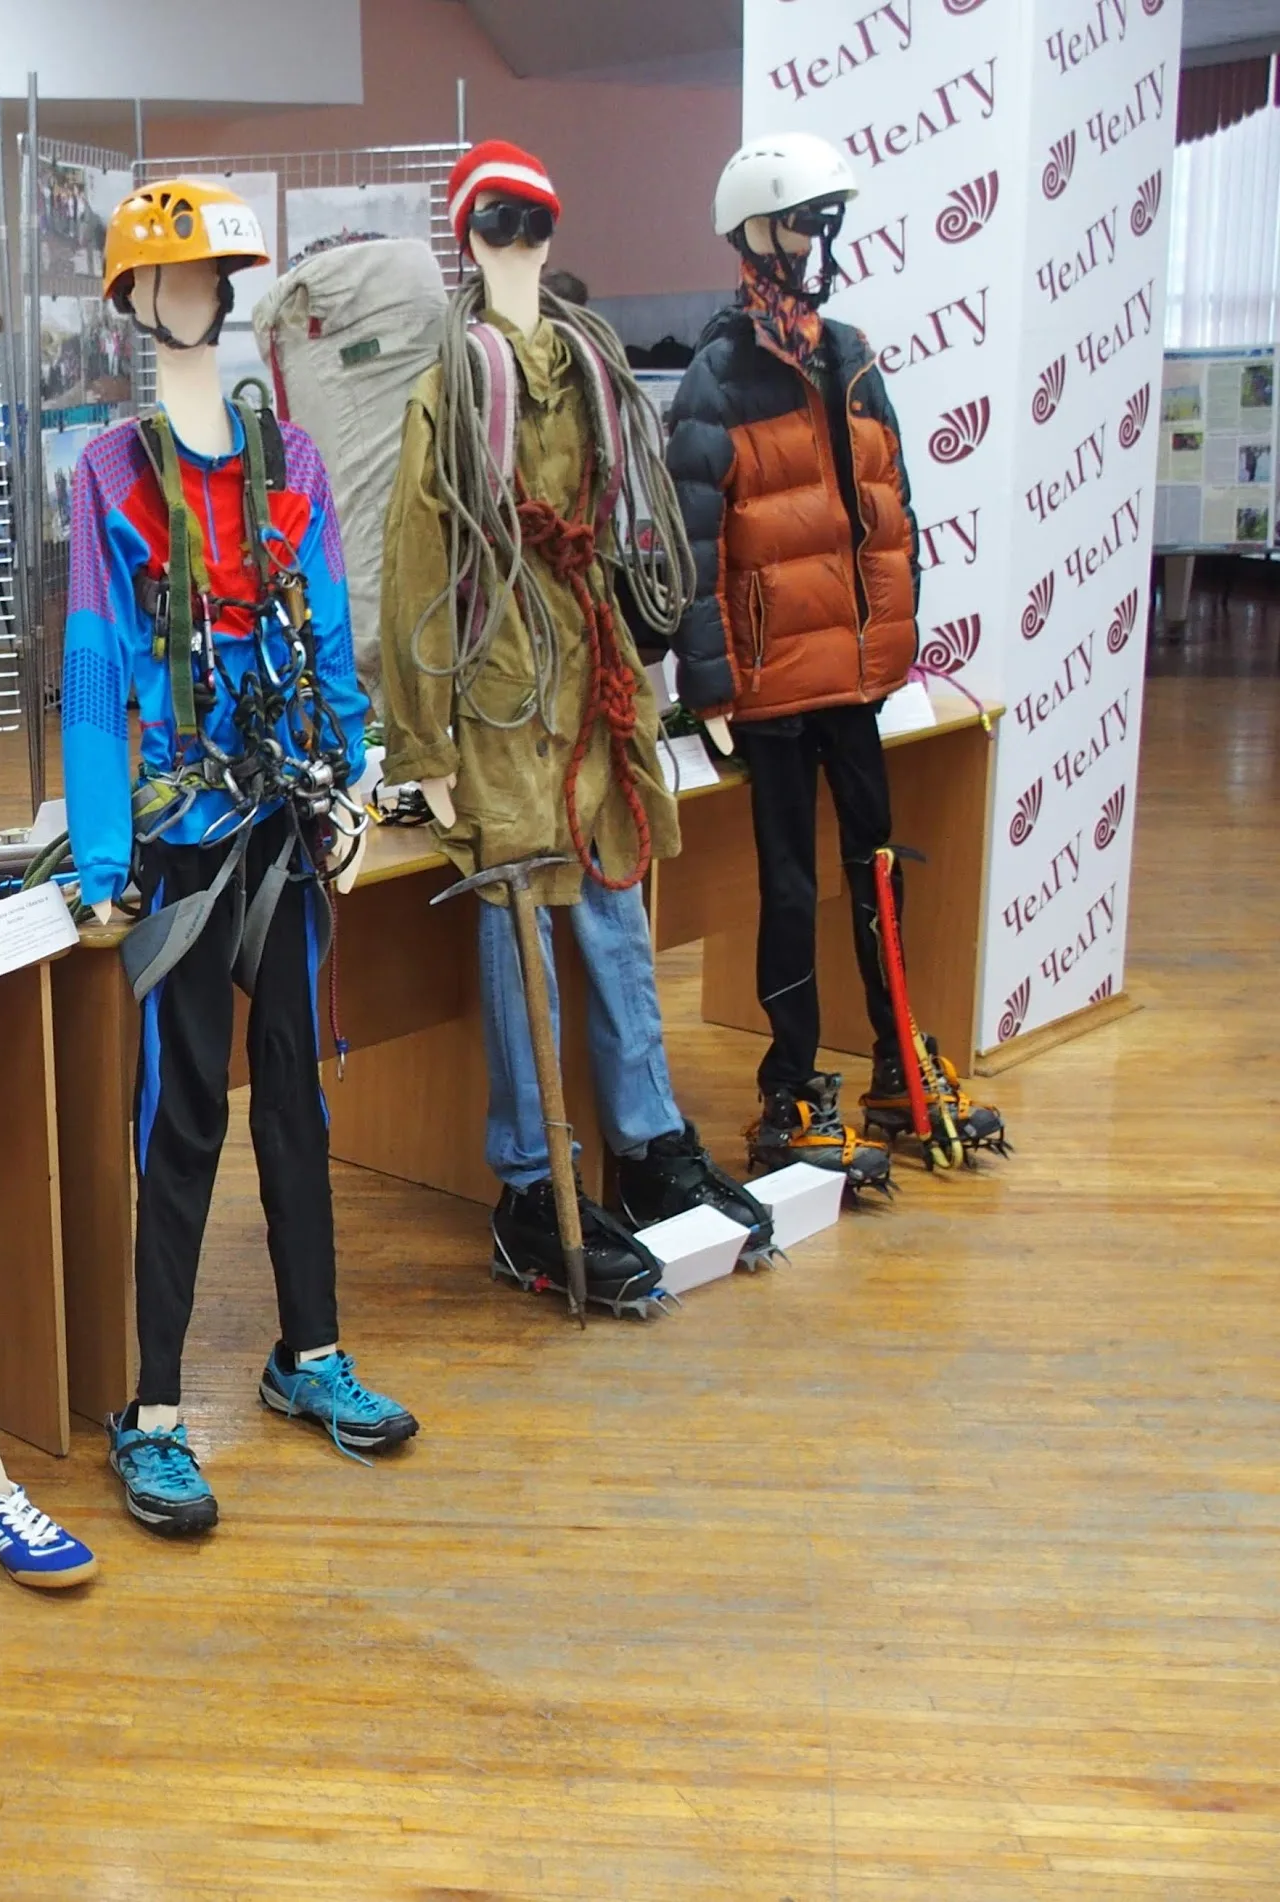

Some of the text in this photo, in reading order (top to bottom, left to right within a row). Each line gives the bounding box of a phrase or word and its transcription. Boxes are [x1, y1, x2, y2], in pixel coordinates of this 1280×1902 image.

[769, 0, 912, 101] ЧелГУ
[844, 57, 998, 168] ЧелГУ
[1086, 62, 1165, 155] ЧелГУ
[217, 217, 257, 237] 12.1
[1036, 206, 1118, 303] ЧелГУ
[877, 287, 989, 375] елГУ
[1075, 280, 1154, 375] ЧелГУ
[1025, 423, 1106, 524] ЧелГУ
[1064, 490, 1142, 588] ЧелГУ
[1014, 630, 1095, 735] ЧелГУ
[1053, 688, 1131, 790] ЧелГУ
[1002, 831, 1082, 936] ЧелГУ
[1040, 882, 1117, 986] ЧелГУ
